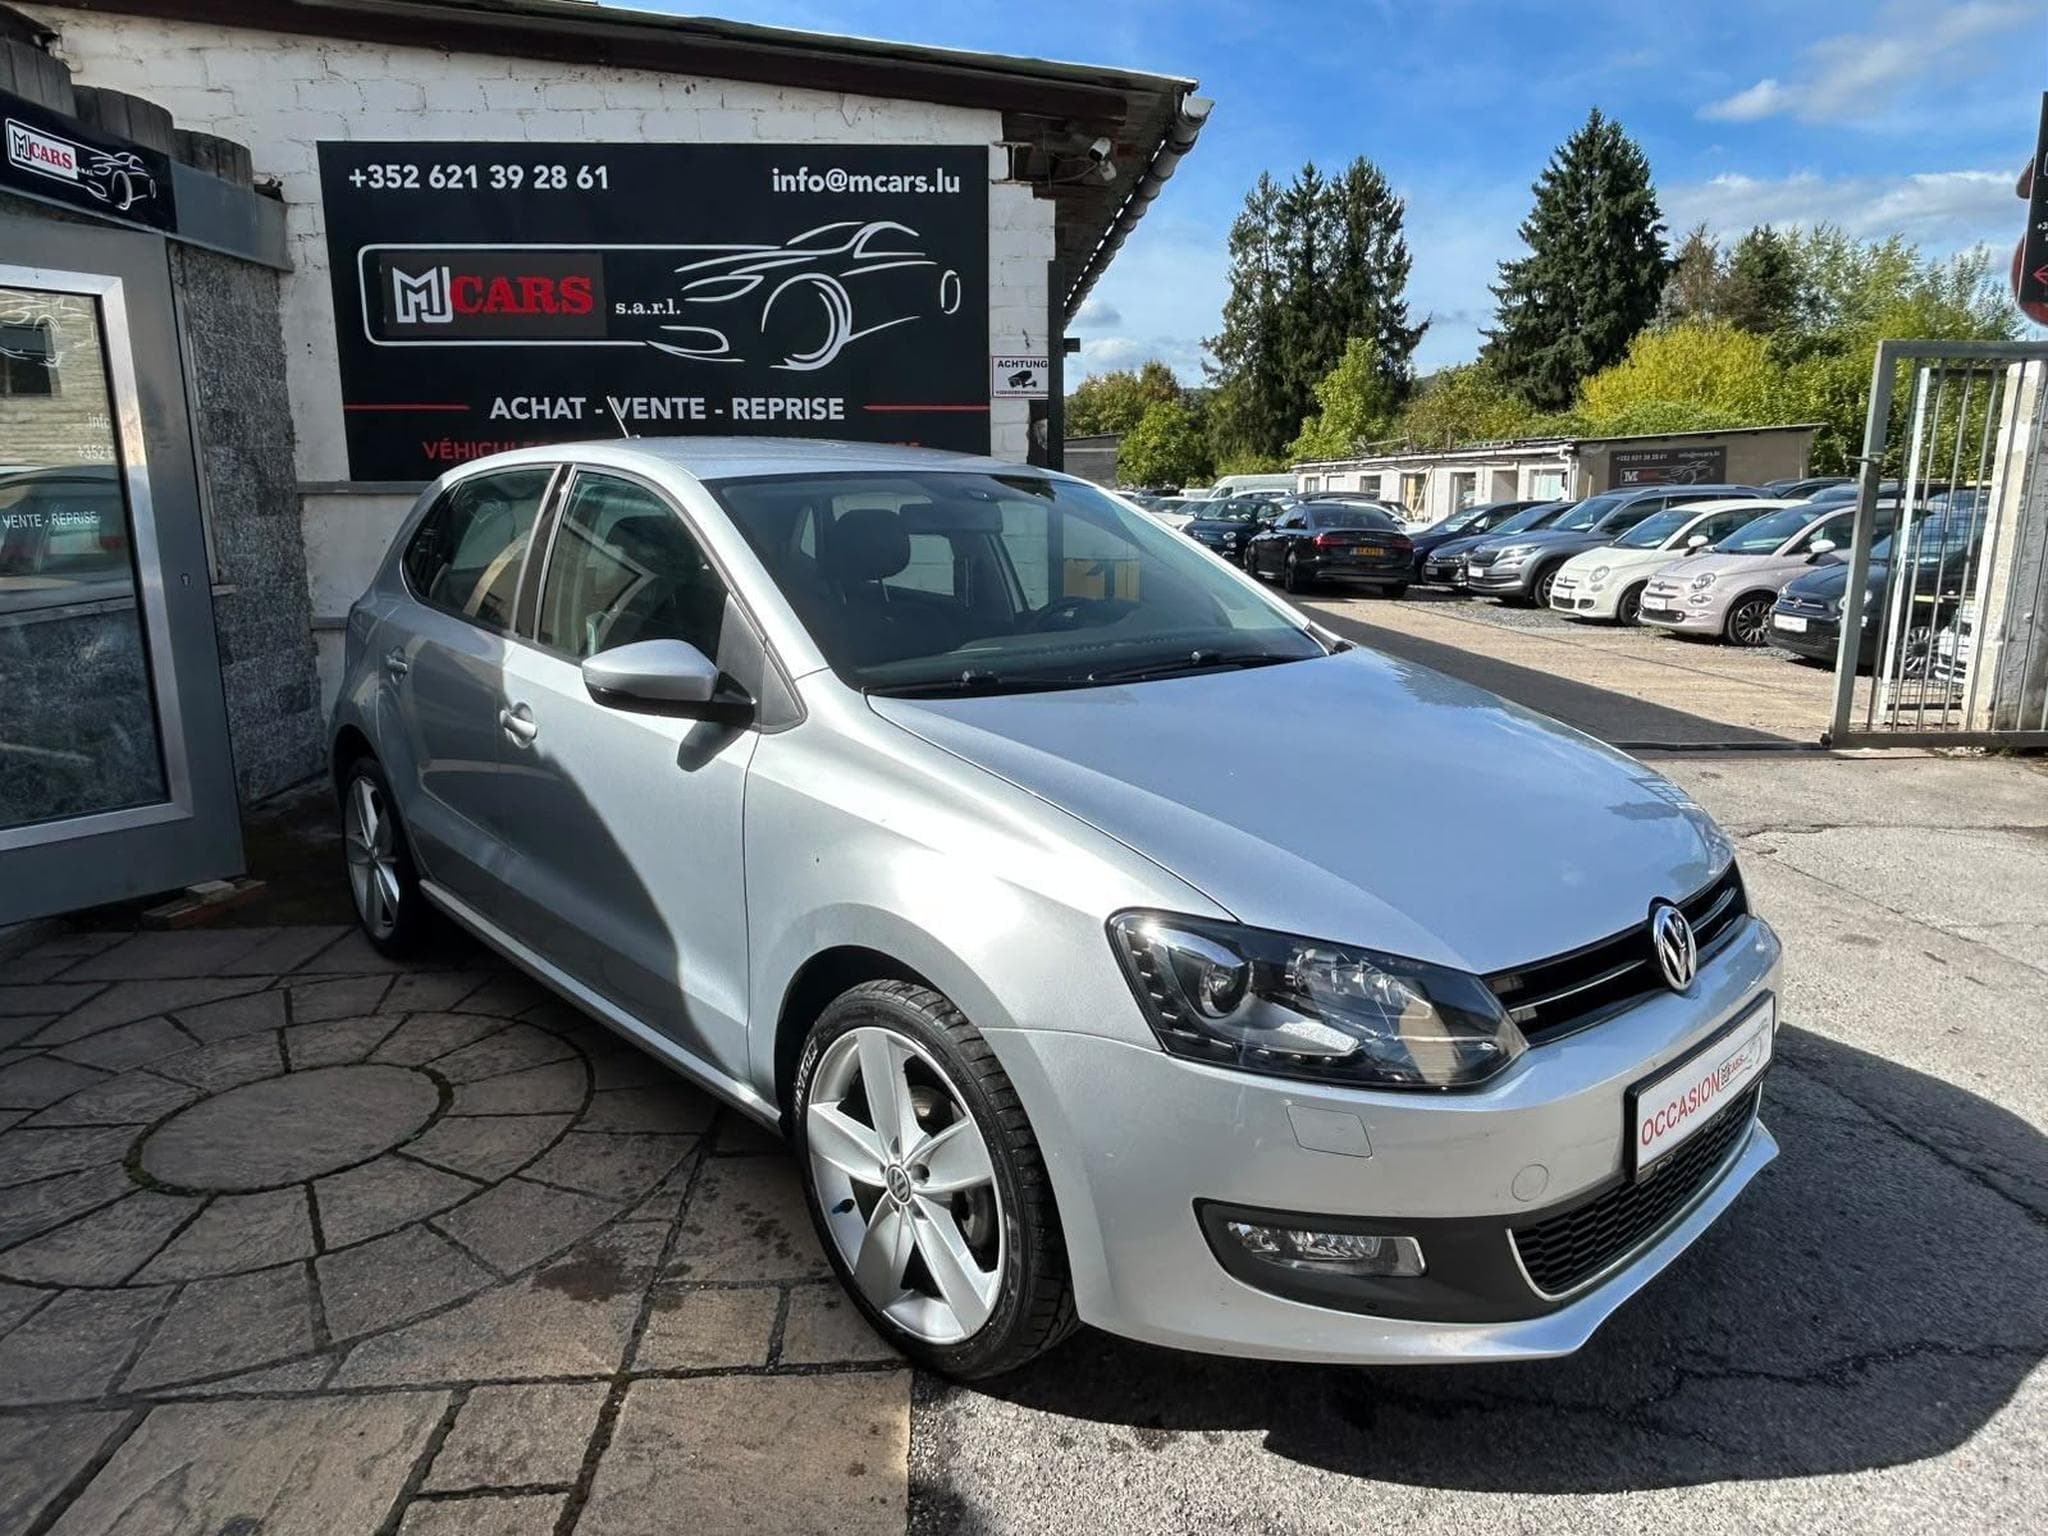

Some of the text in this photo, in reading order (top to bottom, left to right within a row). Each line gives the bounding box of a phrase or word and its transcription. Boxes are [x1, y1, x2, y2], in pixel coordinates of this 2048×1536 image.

[349, 165, 609, 189] +352 621 39 28 61
[772, 167, 960, 193] info@mcars.lu
[615, 299, 681, 315] s.a.r.l.
[997, 360, 1048, 369] ACHTUNG
[489, 397, 586, 420] ACHAT
[612, 397, 706, 420] VENTE
[732, 397, 845, 420] REPRISE
[2, 513, 42, 529] VENTE
[51, 511, 98, 526] REPRISE
[1641, 1068, 1720, 1146] OCCASION
